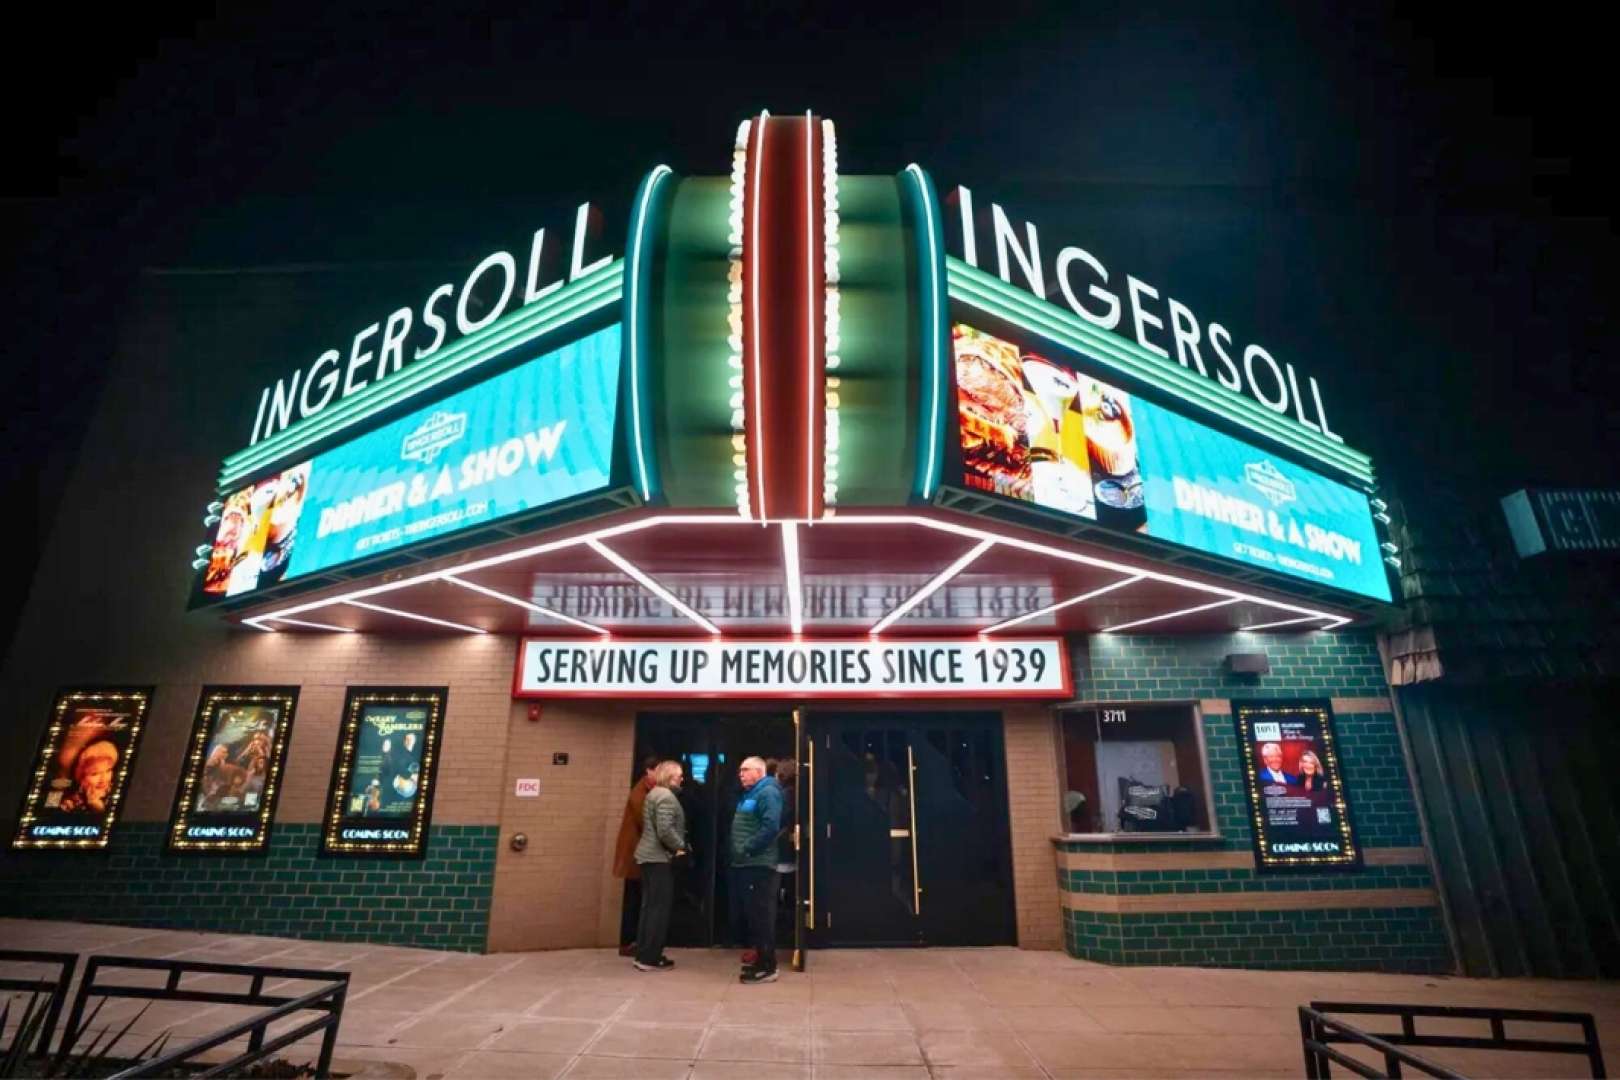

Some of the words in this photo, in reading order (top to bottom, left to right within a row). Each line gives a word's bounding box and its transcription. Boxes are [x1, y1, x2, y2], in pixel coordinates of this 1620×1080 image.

[250, 201, 613, 445] INGERSOLL
[958, 184, 1343, 444] INGERSOLL
[316, 481, 406, 539] DINNER
[407, 472, 428, 506] &
[431, 463, 454, 500] A
[458, 419, 567, 491] SHOW
[1173, 475, 1267, 536] DINNER
[1288, 517, 1305, 549] A
[1304, 523, 1361, 566] SHOW
[537, 648, 658, 683] SERVING
[670, 648, 708, 683] UP
[720, 648, 872, 683] MEMORIES
[882, 648, 963, 683] SINCE
[975, 647, 1047, 683] 1939
[1104, 710, 1126, 721] 3711
[33, 826, 72, 836] COMING
[73, 826, 99, 836] SOON
[187, 827, 226, 837] COMING
[227, 827, 254, 837] SOON
[342, 829, 381, 839] COMING
[382, 829, 409, 839] SOON
[1272, 843, 1312, 853] COMING
[1312, 842, 1339, 852] SOON
